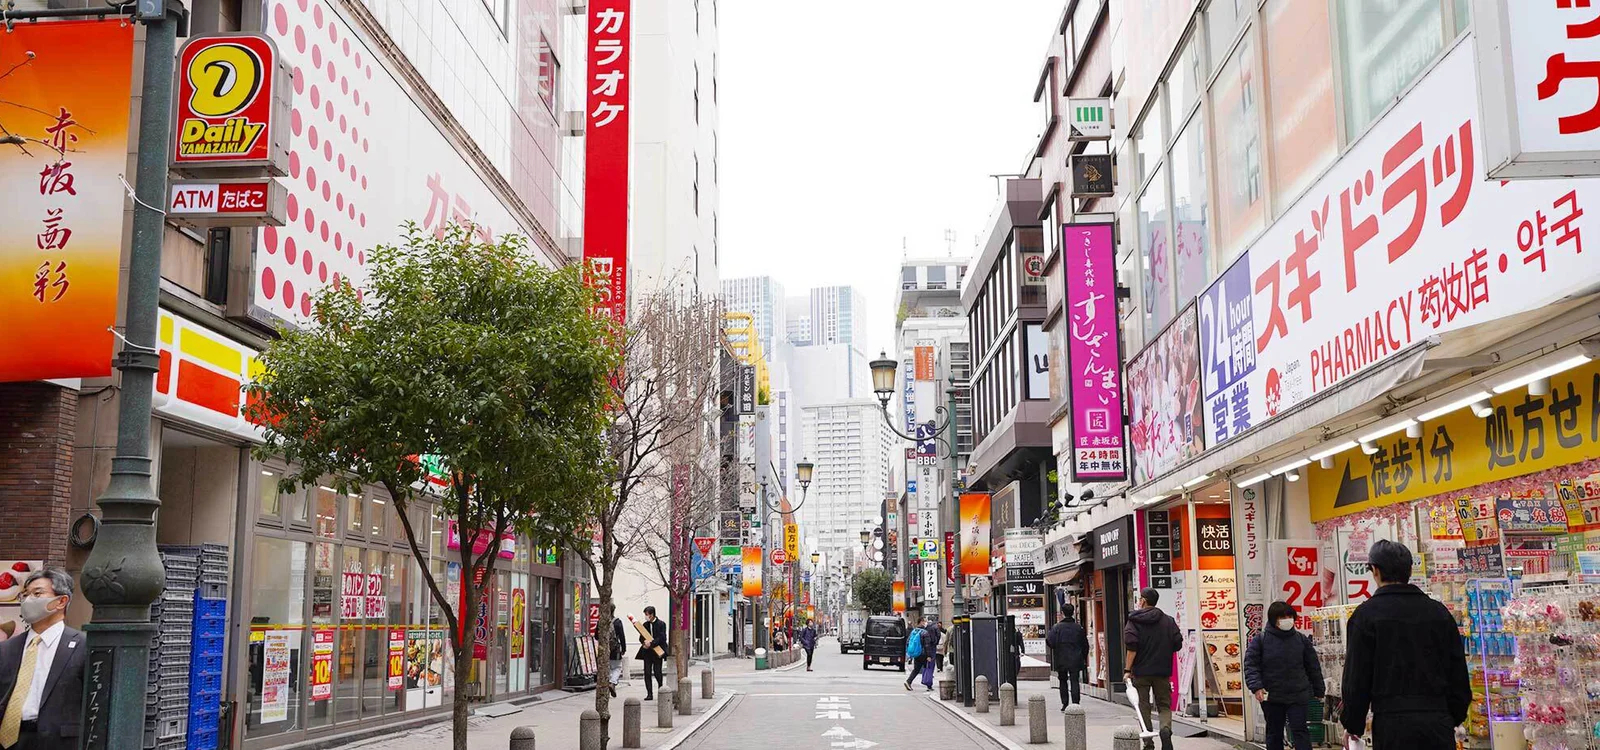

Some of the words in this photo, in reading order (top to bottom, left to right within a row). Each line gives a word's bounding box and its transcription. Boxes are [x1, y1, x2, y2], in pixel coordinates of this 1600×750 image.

[591, 8, 624, 128] カラオケ
[181, 118, 265, 152] Daily
[181, 143, 239, 154] YAMAZAKI
[33, 107, 78, 303] 赤坂茜彩
[172, 189, 213, 208] ATM
[221, 189, 263, 208] たばこ
[1310, 291, 1413, 393] PHARMACY
[1418, 248, 1490, 330] 药妆店
[1516, 188, 1584, 273] 약국
[1072, 291, 1118, 405] すしざんまい
[1201, 279, 1233, 395] 24
[1229, 294, 1250, 330] hour
[1230, 320, 1255, 377] 時間
[1213, 380, 1251, 444] 営業
[1092, 436, 1119, 446] 赤坂店
[1369, 424, 1454, 499] 徒歩1分
[1486, 373, 1600, 472] 処方せ
[917, 456, 936, 465] BBC
[1079, 461, 1122, 471] 年中無休
[1080, 451, 1119, 460] 24時間
[1201, 524, 1229, 538] 快活
[1202, 540, 1230, 549] CLUB
[1244, 502, 1256, 560] スギドラッグ
[1200, 600, 1237, 610] ドラッグ
[1206, 590, 1231, 600] スギ
[1283, 581, 1322, 612] 24
